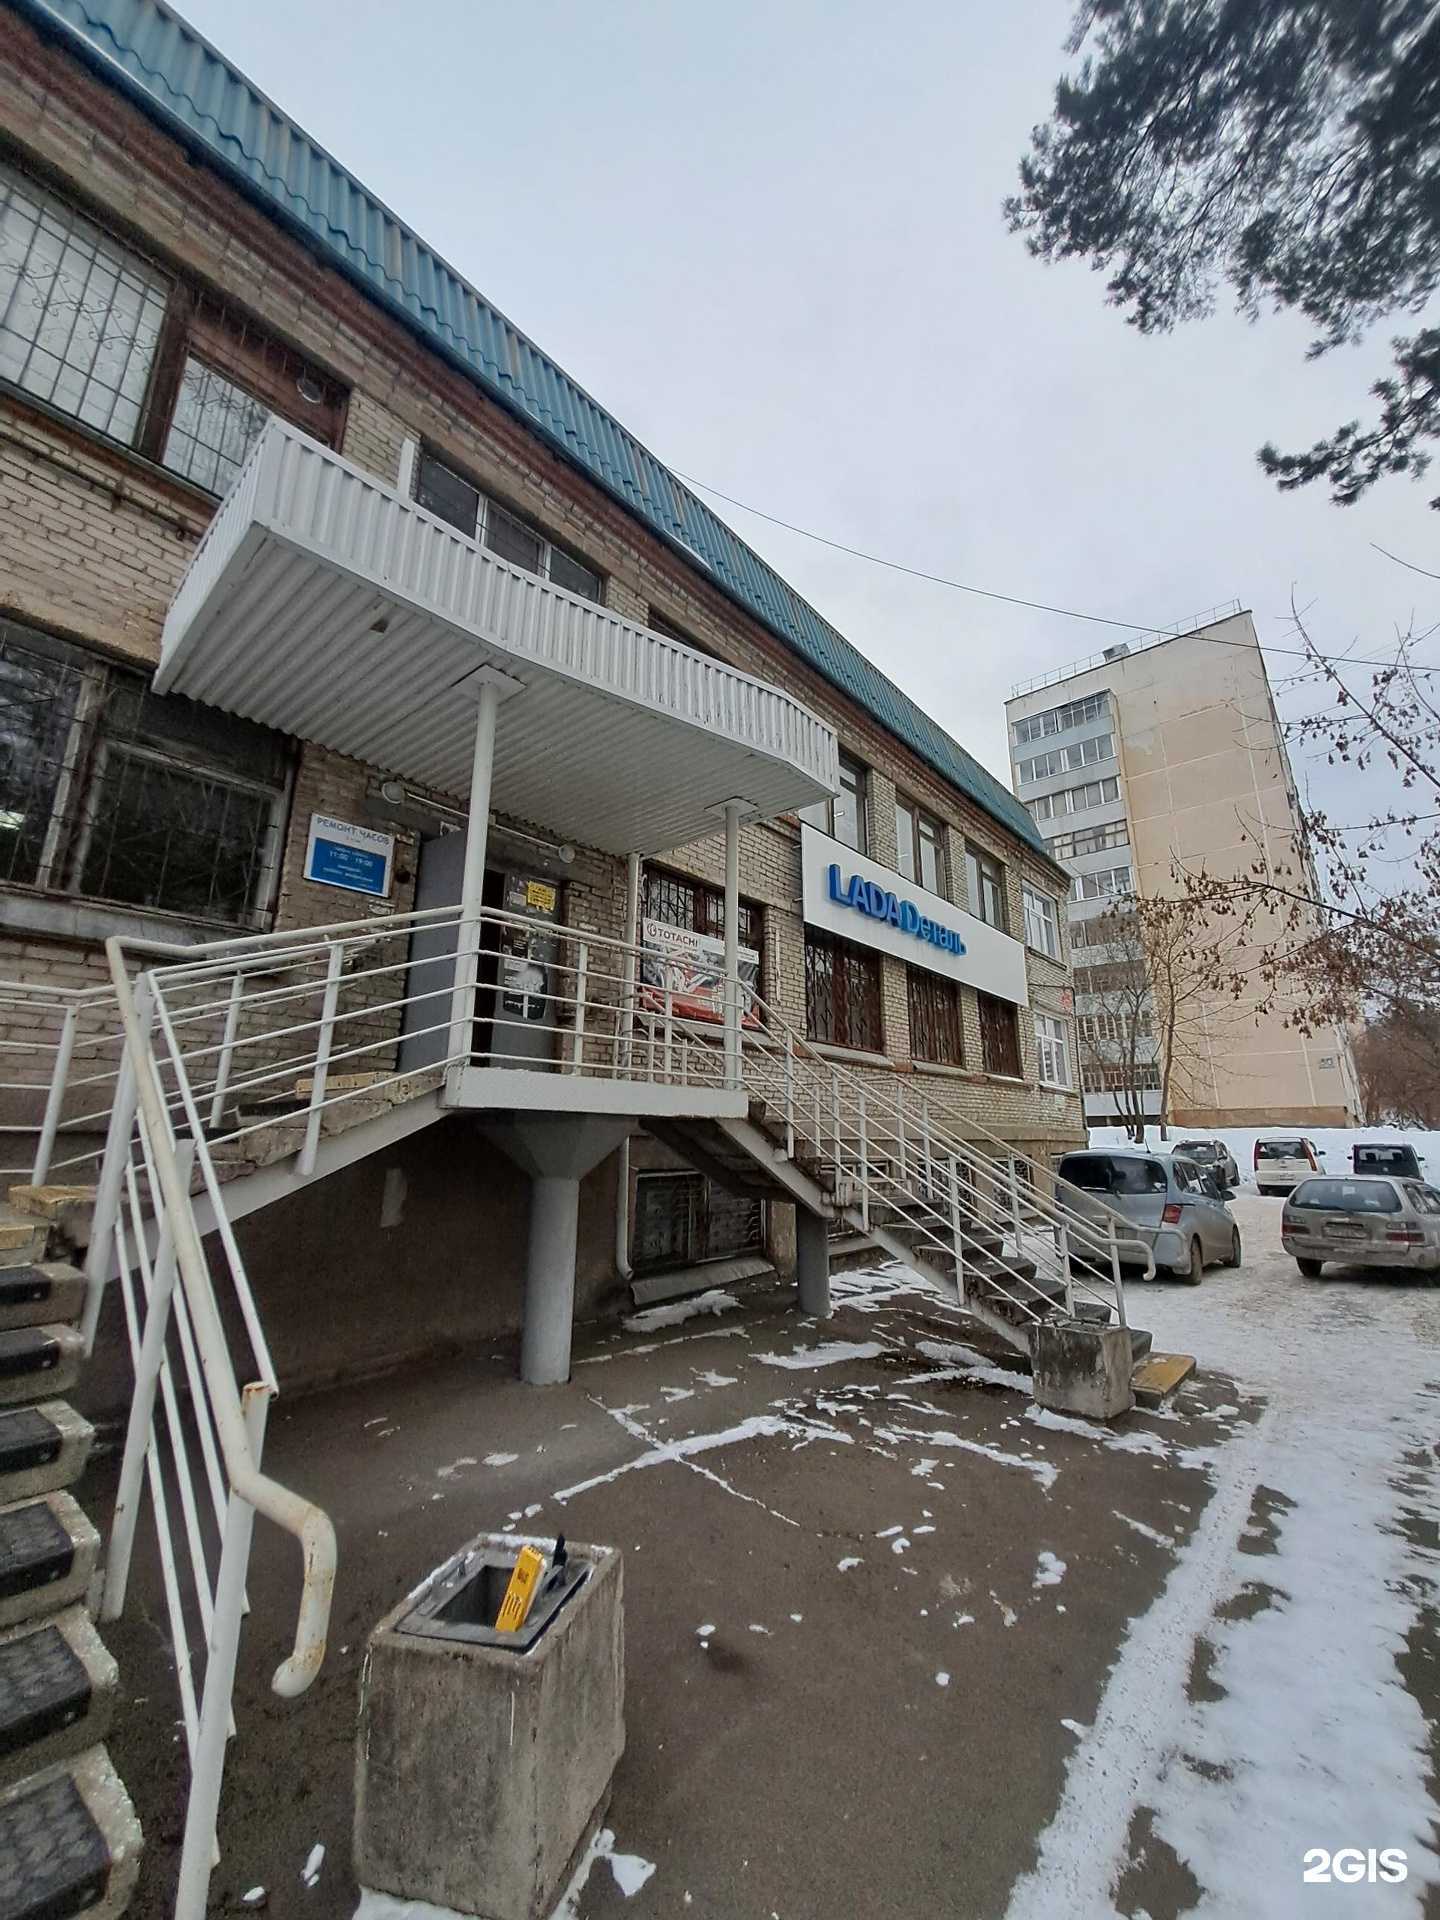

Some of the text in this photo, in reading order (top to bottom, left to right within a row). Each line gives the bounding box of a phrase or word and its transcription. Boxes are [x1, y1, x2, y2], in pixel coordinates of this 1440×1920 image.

[316, 816, 358, 835] РЕМОНТ
[359, 831, 390, 846] ЧАСОВ
[827, 863, 902, 928] LADA
[657, 927, 699, 948] TOTACHI
